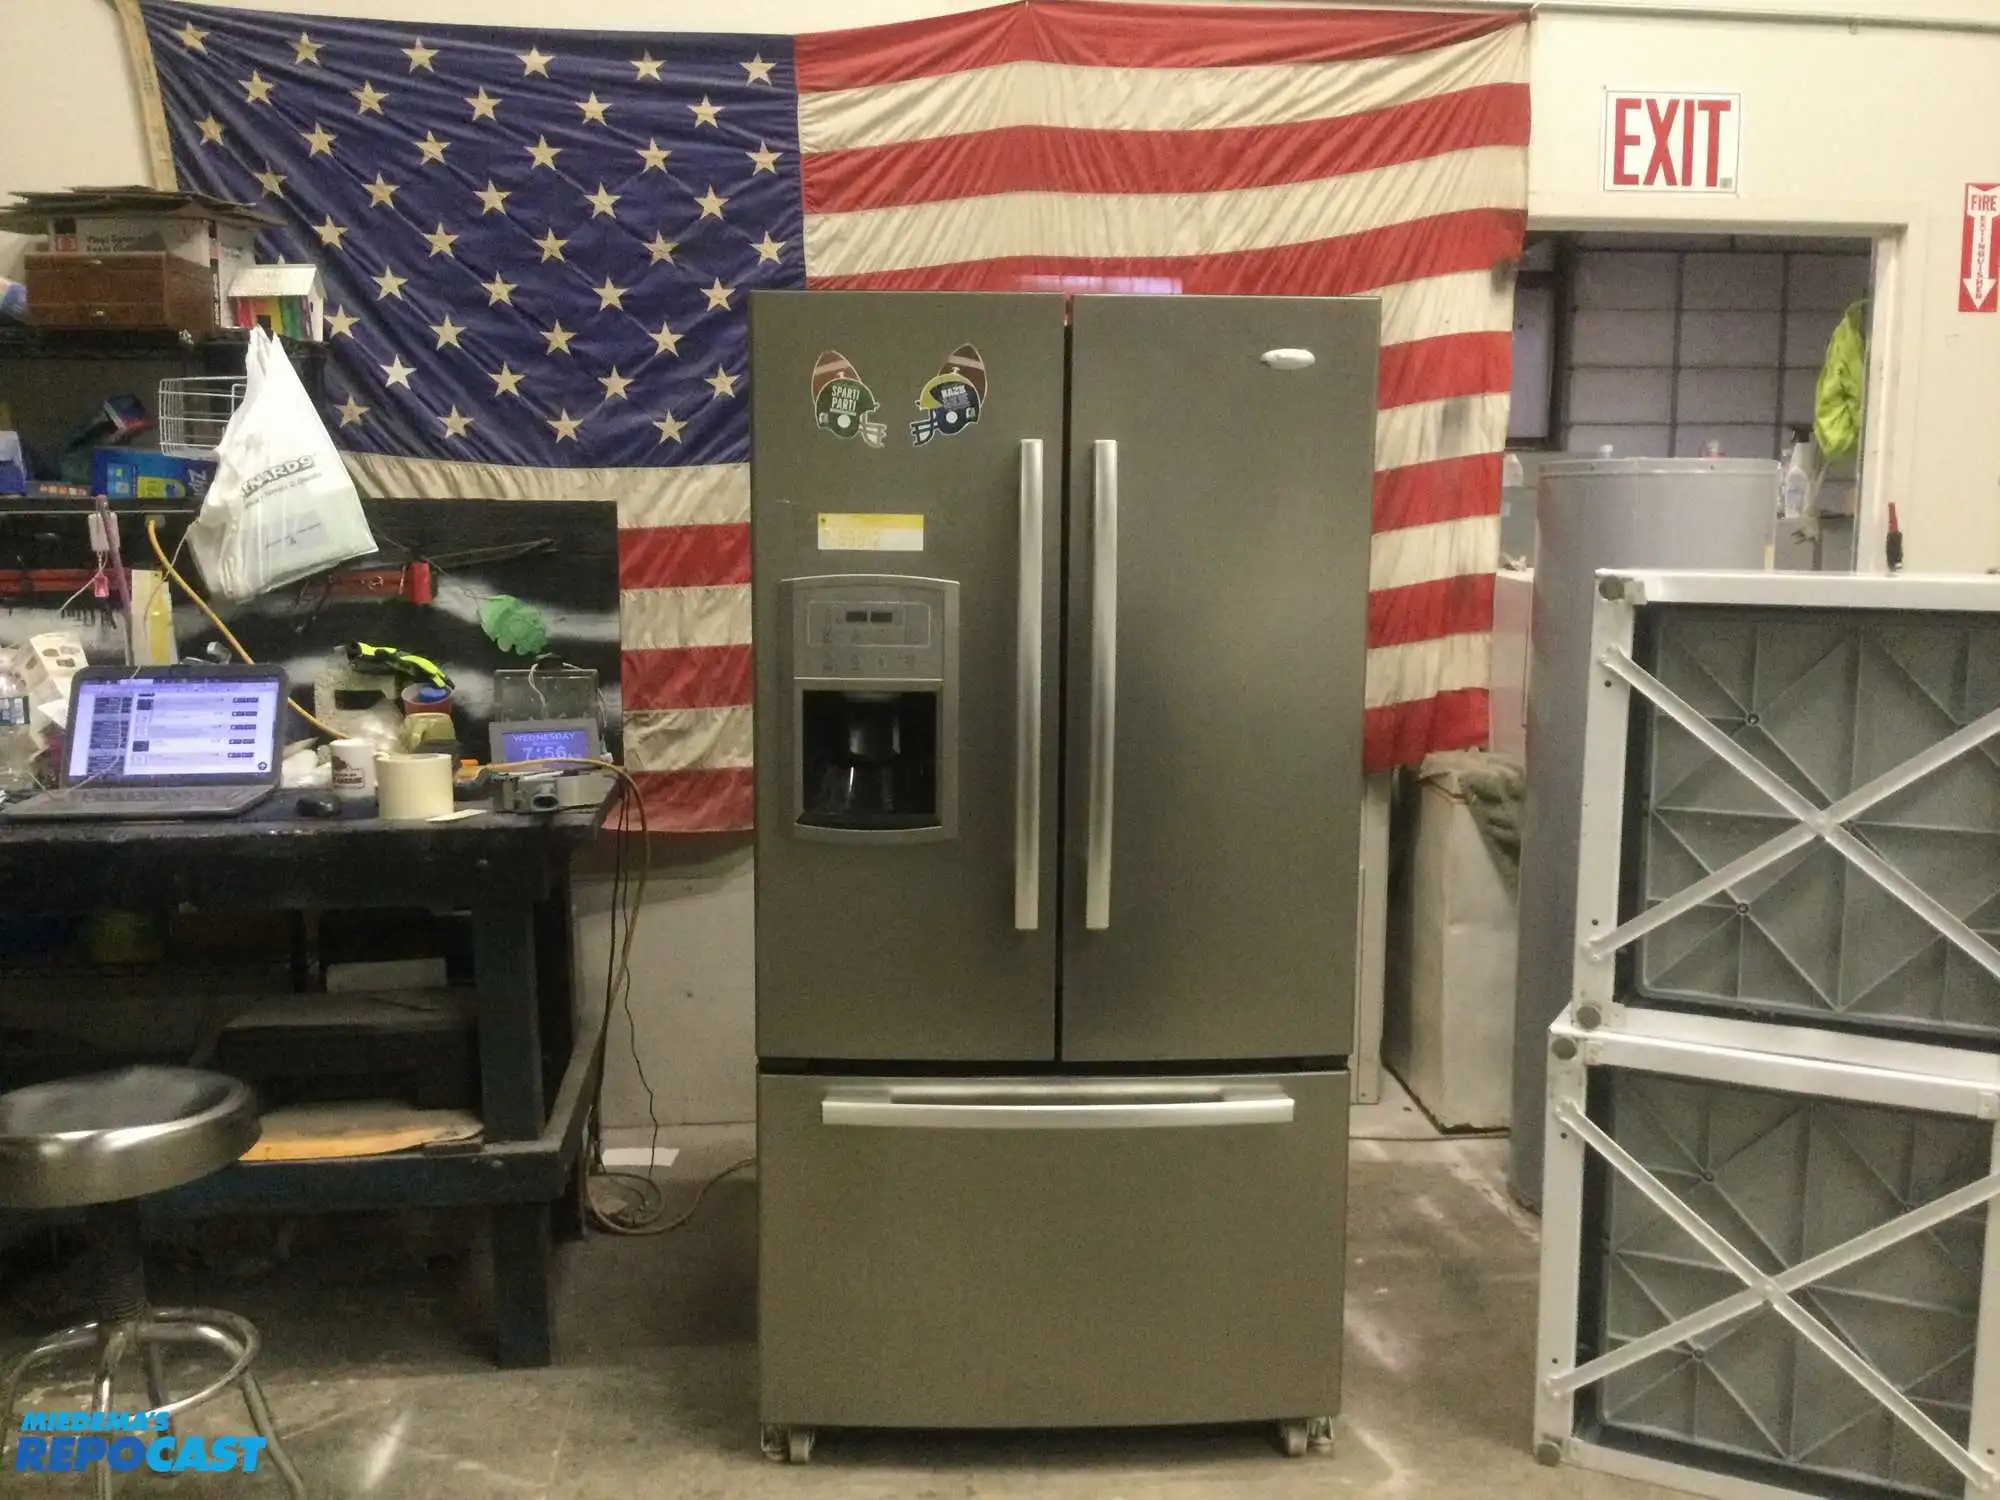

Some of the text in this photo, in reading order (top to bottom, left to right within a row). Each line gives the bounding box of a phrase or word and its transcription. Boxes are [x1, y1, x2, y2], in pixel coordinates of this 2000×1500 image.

[1612, 97, 1732, 187] EXIT
[1971, 195, 1998, 211] FIRE
[1975, 215, 1986, 299] EXTINGUISHER
[831, 397, 857, 411] PARTI
[511, 732, 576, 743] WEDNESDAY
